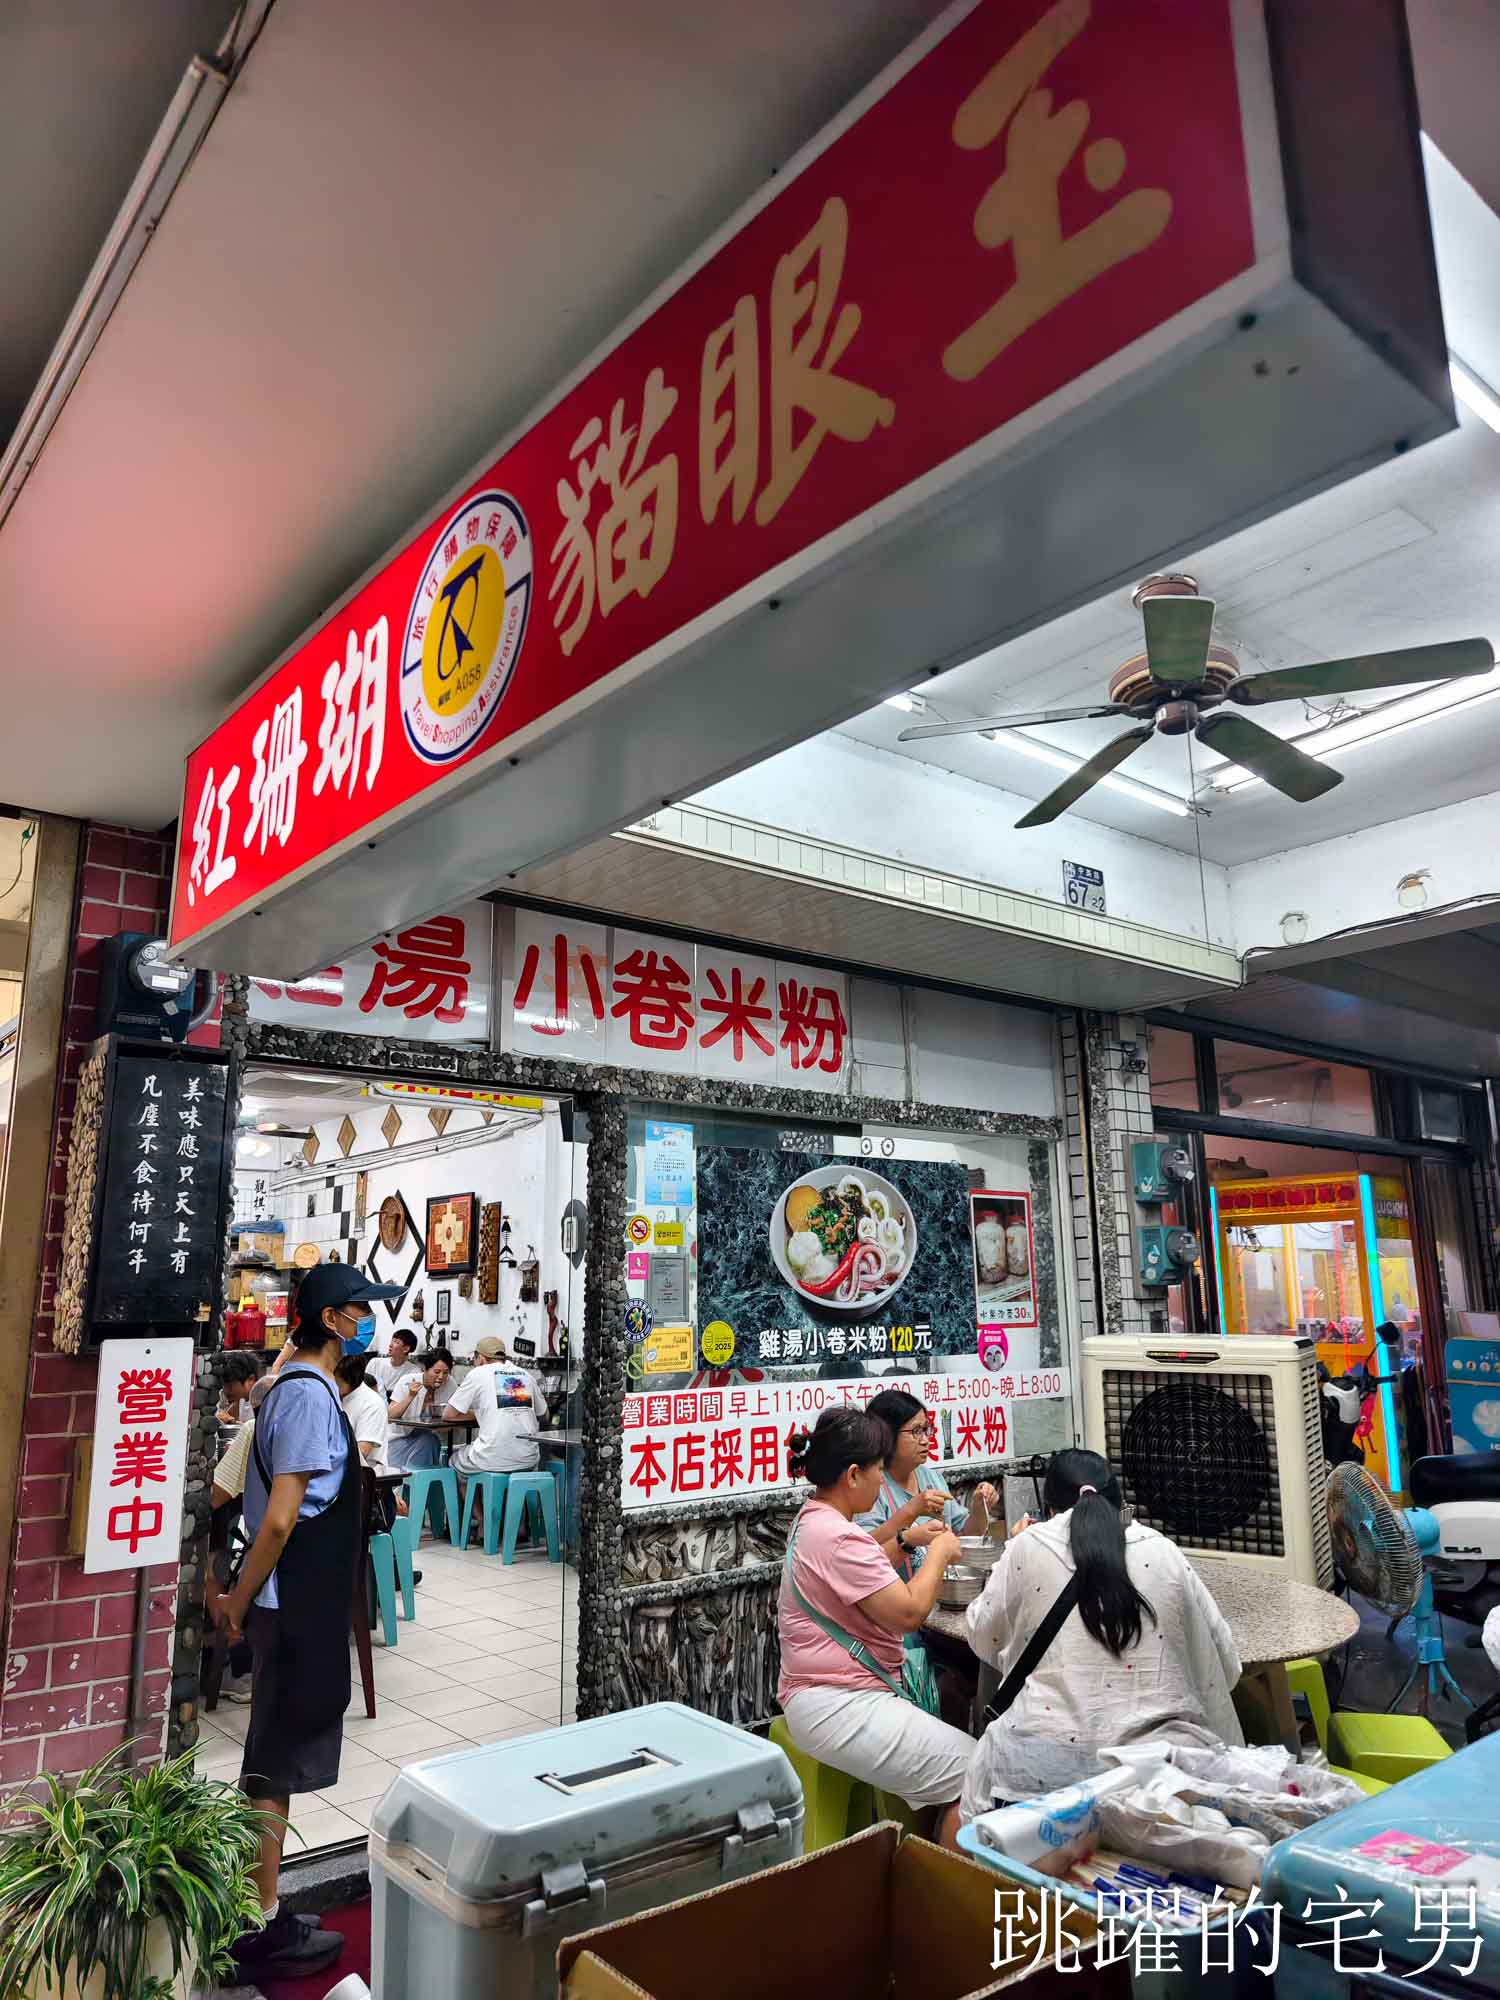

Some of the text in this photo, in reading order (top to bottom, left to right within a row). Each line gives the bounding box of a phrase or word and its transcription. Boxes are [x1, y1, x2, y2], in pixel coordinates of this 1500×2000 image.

[432, 708, 478, 745] Shopping
[479, 605, 519, 712] Assurance
[188, 614, 389, 907] 紅珊瑚
[513, 933, 848, 1074] 小卷米粉
[170, 1077, 204, 1274] 美味應只天上有
[622, 1393, 721, 1427] 營業時間
[759, 1325, 932, 1359] 雞湯小卷米粉120元
[107, 1368, 173, 1553] 營業中
